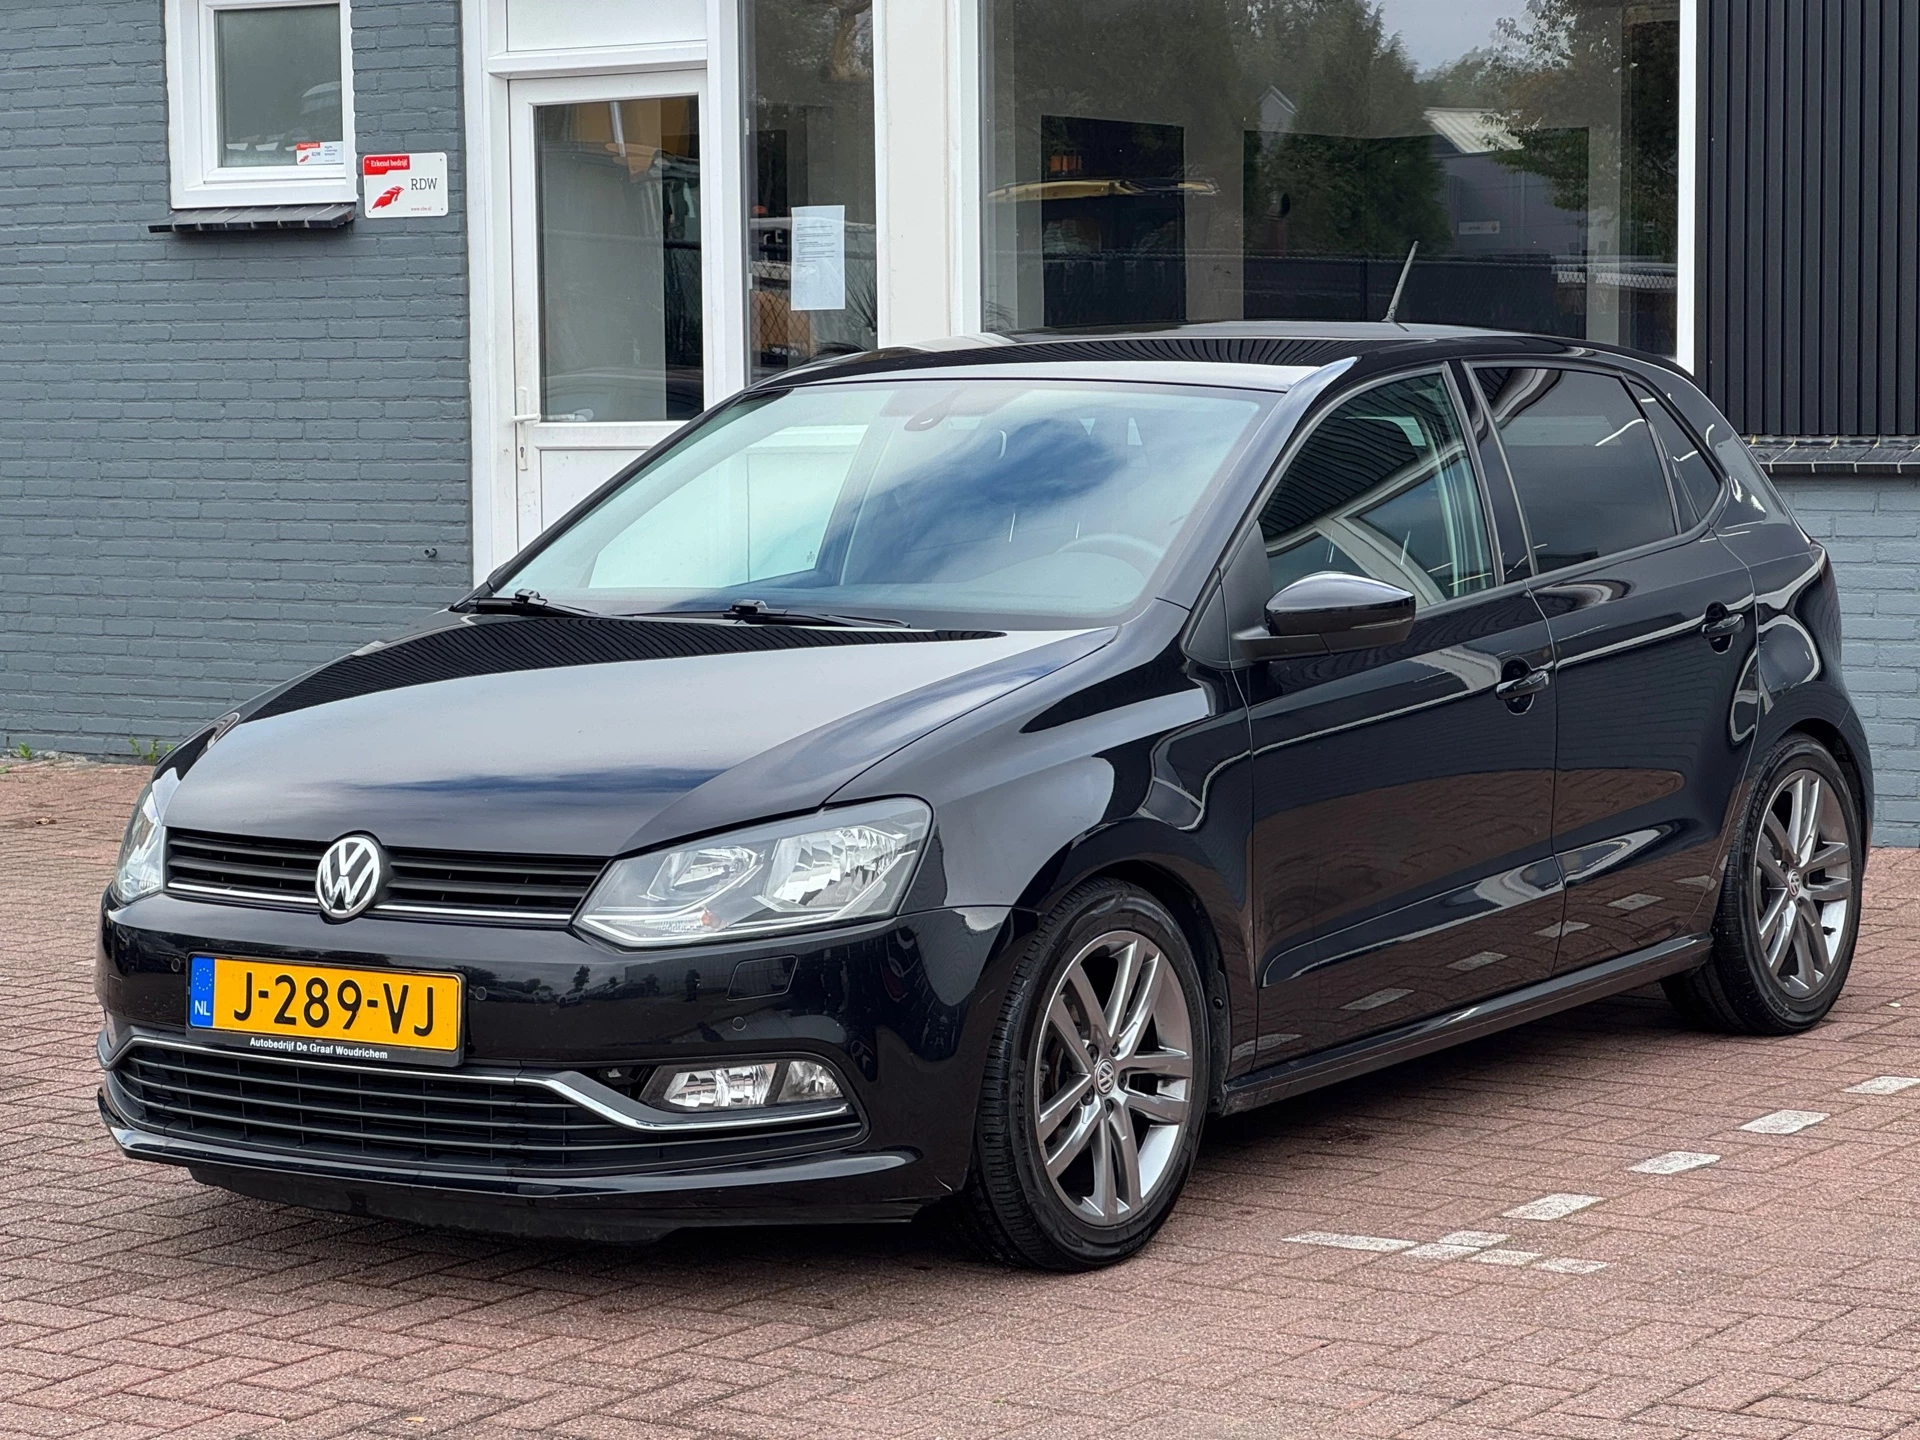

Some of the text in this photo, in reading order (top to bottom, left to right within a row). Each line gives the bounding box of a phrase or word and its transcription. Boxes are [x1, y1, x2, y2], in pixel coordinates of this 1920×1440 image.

[371, 158, 408, 168] Erkend bedrijf
[410, 177, 438, 191] RDW
[194, 999, 211, 1017] NL
[233, 971, 434, 1037] J-289-VJ
[249, 1037, 388, 1060] Autobedrijf De Graaf Woudrichem
